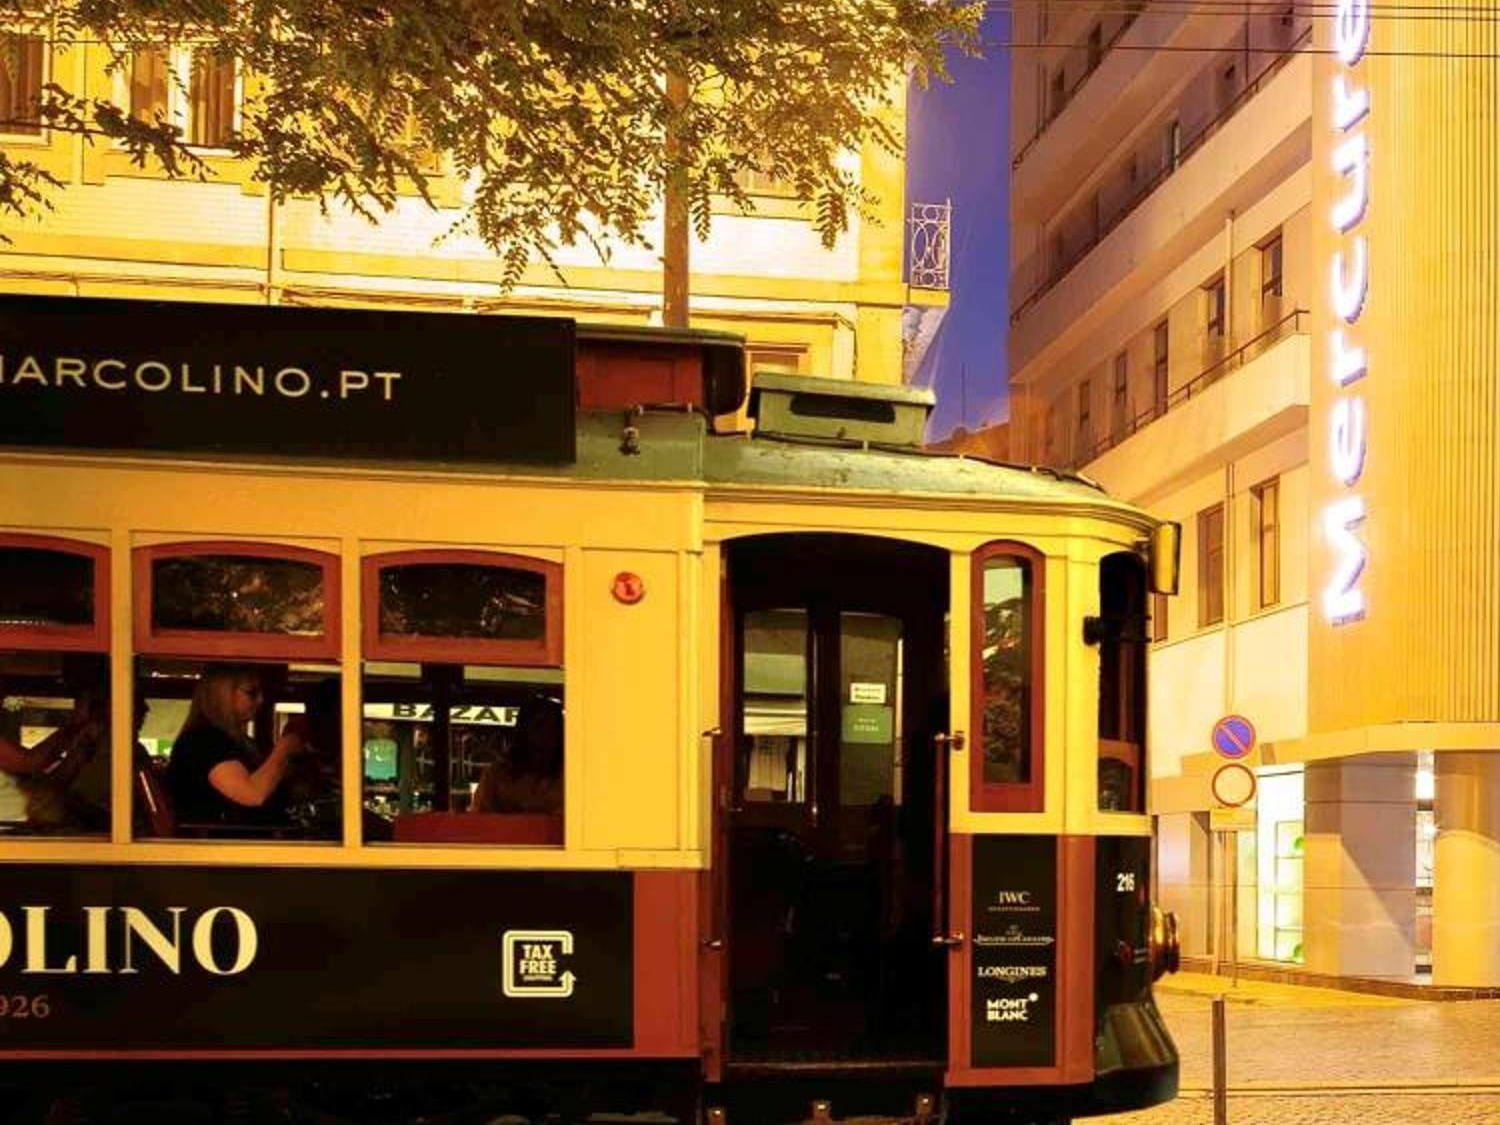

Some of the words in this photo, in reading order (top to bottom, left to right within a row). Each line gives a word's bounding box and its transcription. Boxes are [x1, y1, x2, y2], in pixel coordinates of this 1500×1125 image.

[0, 354, 402, 400] ARCOLINO.PT
[999, 890, 1032, 905] IWC
[0, 905, 258, 975] LINO
[521, 944, 554, 960] TAX
[519, 959, 557, 975] FREE
[977, 966, 1048, 978] LONGINES
[986, 998, 1028, 1010] MONT
[986, 1010, 1029, 1022] BLANC
